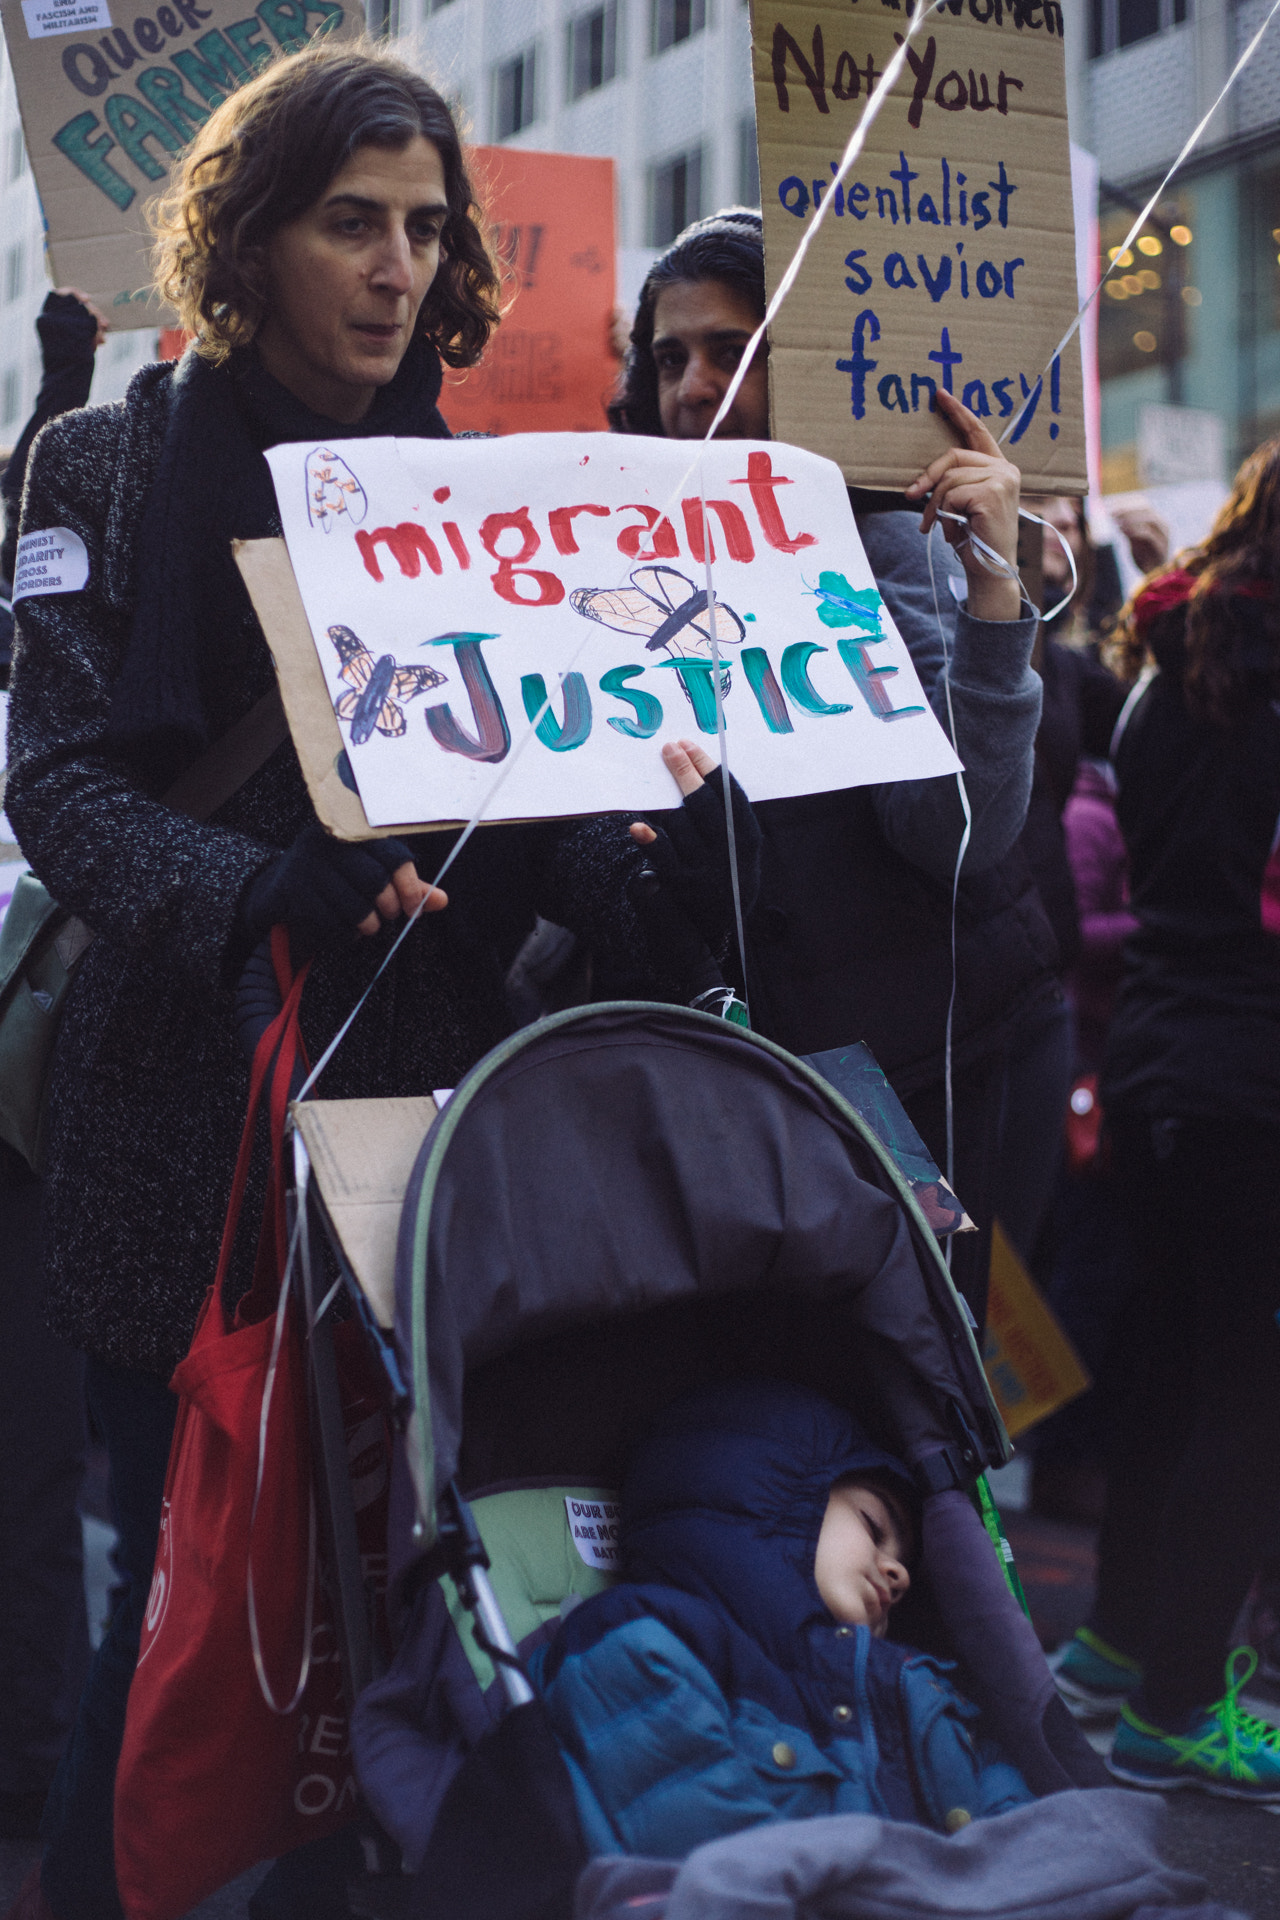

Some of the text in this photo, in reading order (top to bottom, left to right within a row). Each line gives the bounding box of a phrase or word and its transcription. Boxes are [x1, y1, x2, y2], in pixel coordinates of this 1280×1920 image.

[36, 5, 99, 21] FASCISM AND
[42, 15, 98, 31] MILITARISM
[771, 22, 1024, 130] Not Your
[778, 150, 1018, 231] orientalist
[845, 242, 1025, 303] savior
[835, 309, 1062, 445] fantasy!
[354, 451, 819, 607] migrant
[419, 631, 927, 764] JUSTICE
[571, 1502, 603, 1519] OUR
[574, 1525, 597, 1540] ARE
